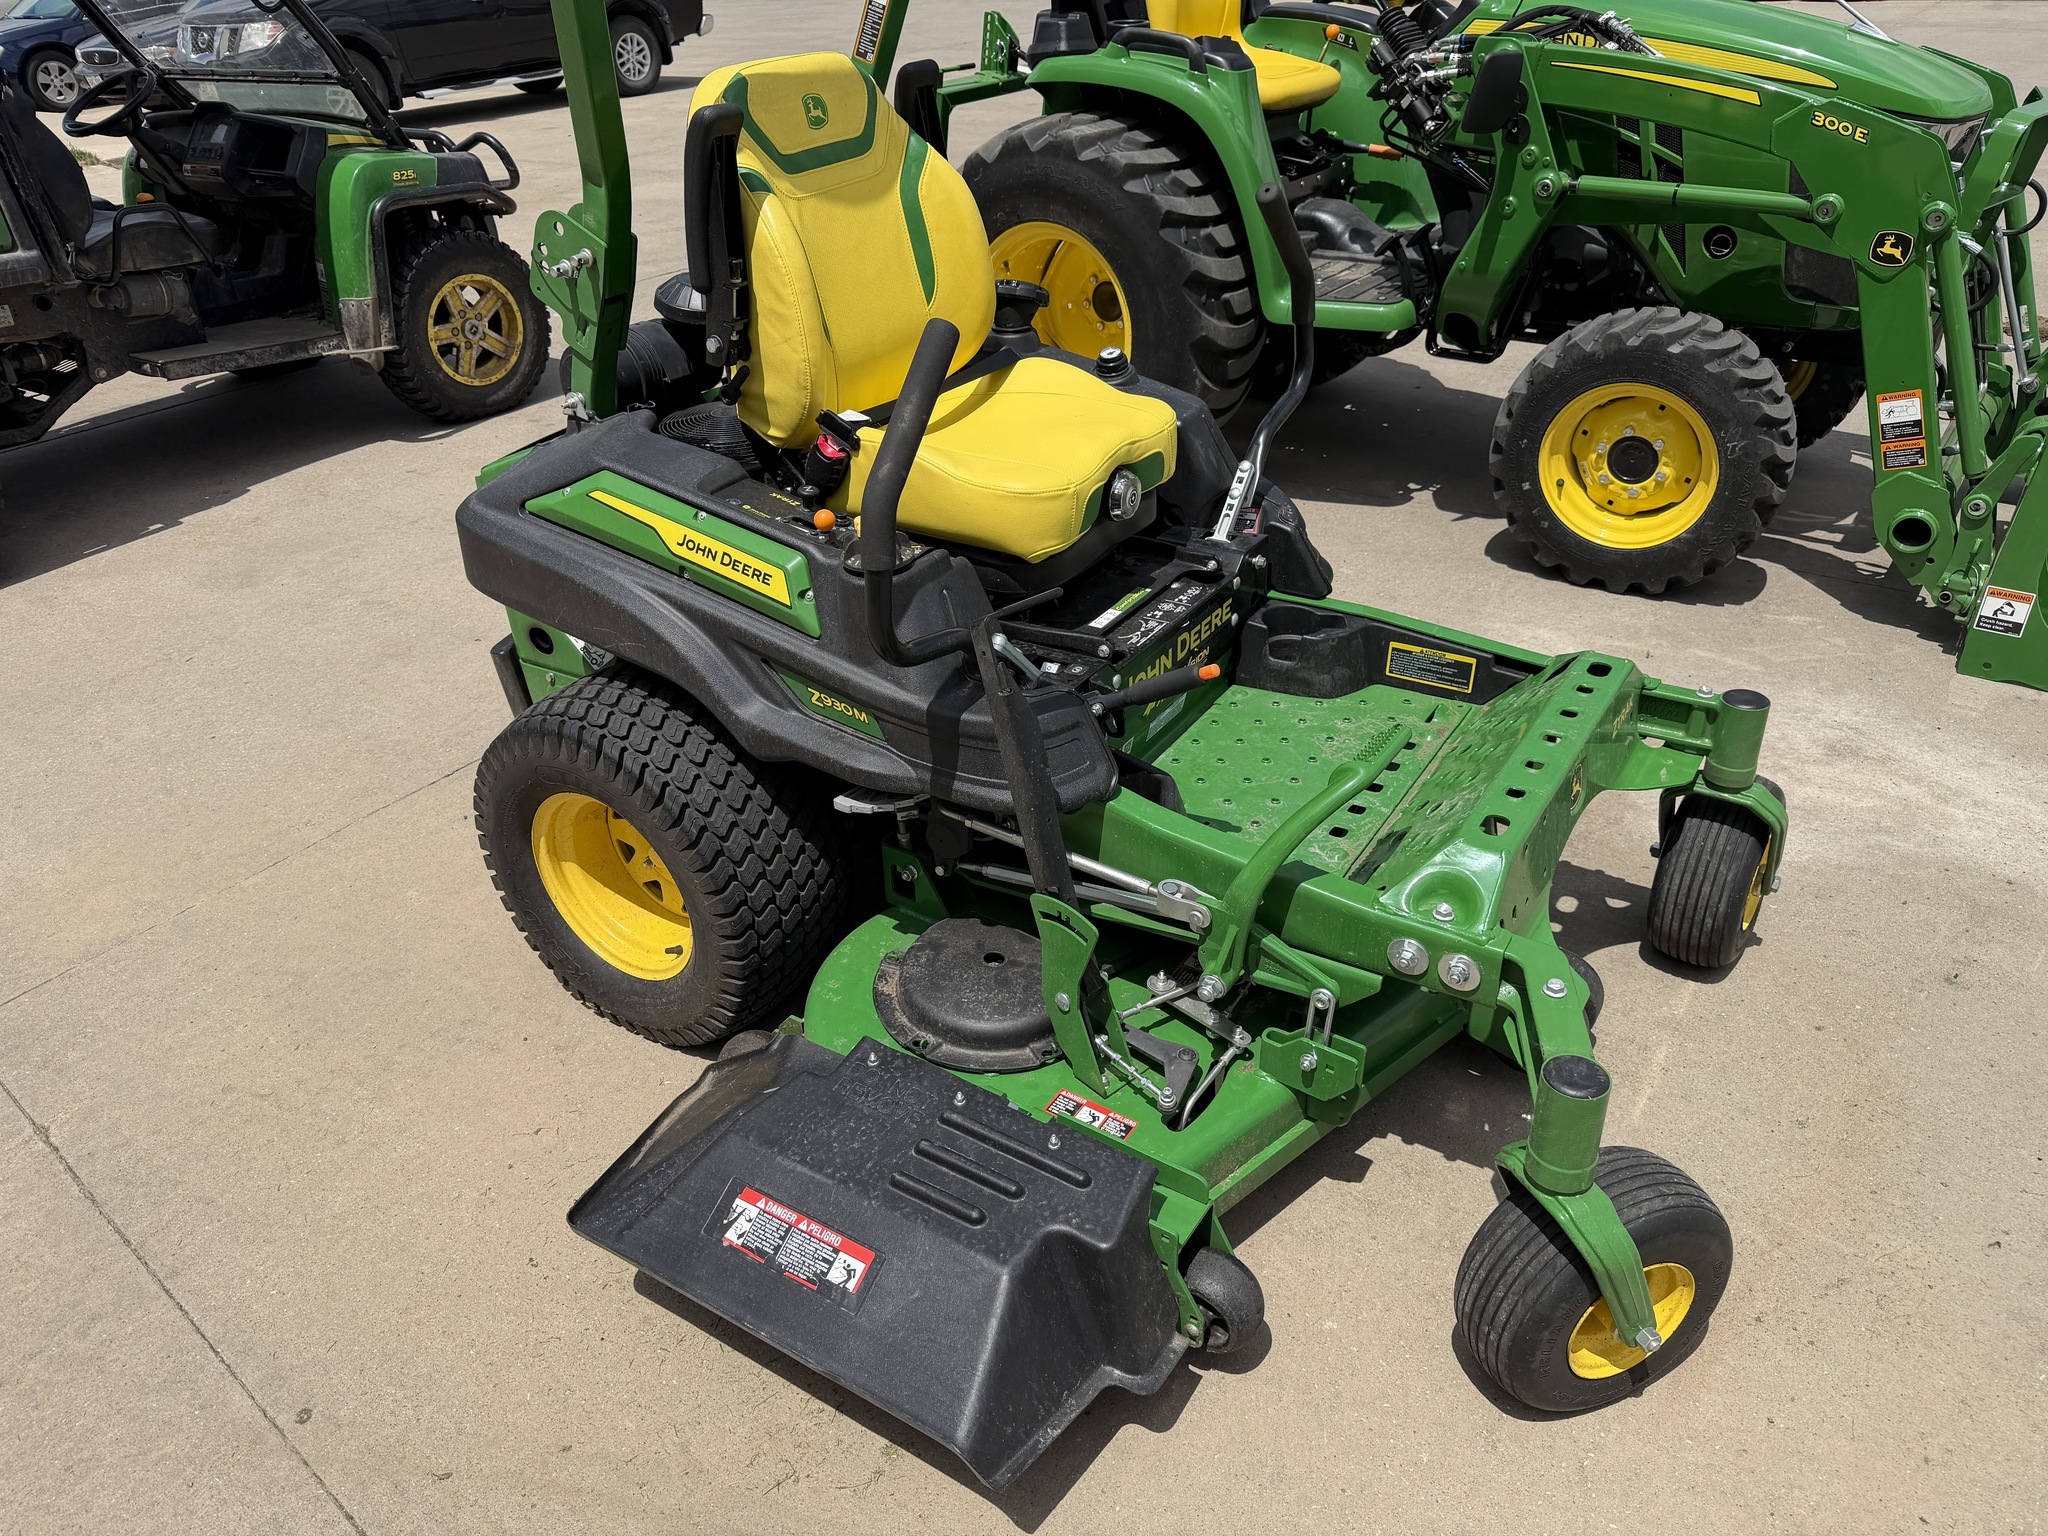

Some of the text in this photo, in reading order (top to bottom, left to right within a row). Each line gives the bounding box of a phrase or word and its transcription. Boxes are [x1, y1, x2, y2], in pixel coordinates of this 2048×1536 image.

[1888, 391, 1917, 400] WARNING
[1892, 441, 1921, 449] WARNING
[676, 533, 773, 587] JOHN DEERE
[1996, 590, 2031, 602] WARNING
[1176, 597, 1233, 662] DEERE
[807, 687, 869, 724] Z930M
[765, 1201, 798, 1224] DANGER
[808, 1223, 842, 1247] PELIGRO
